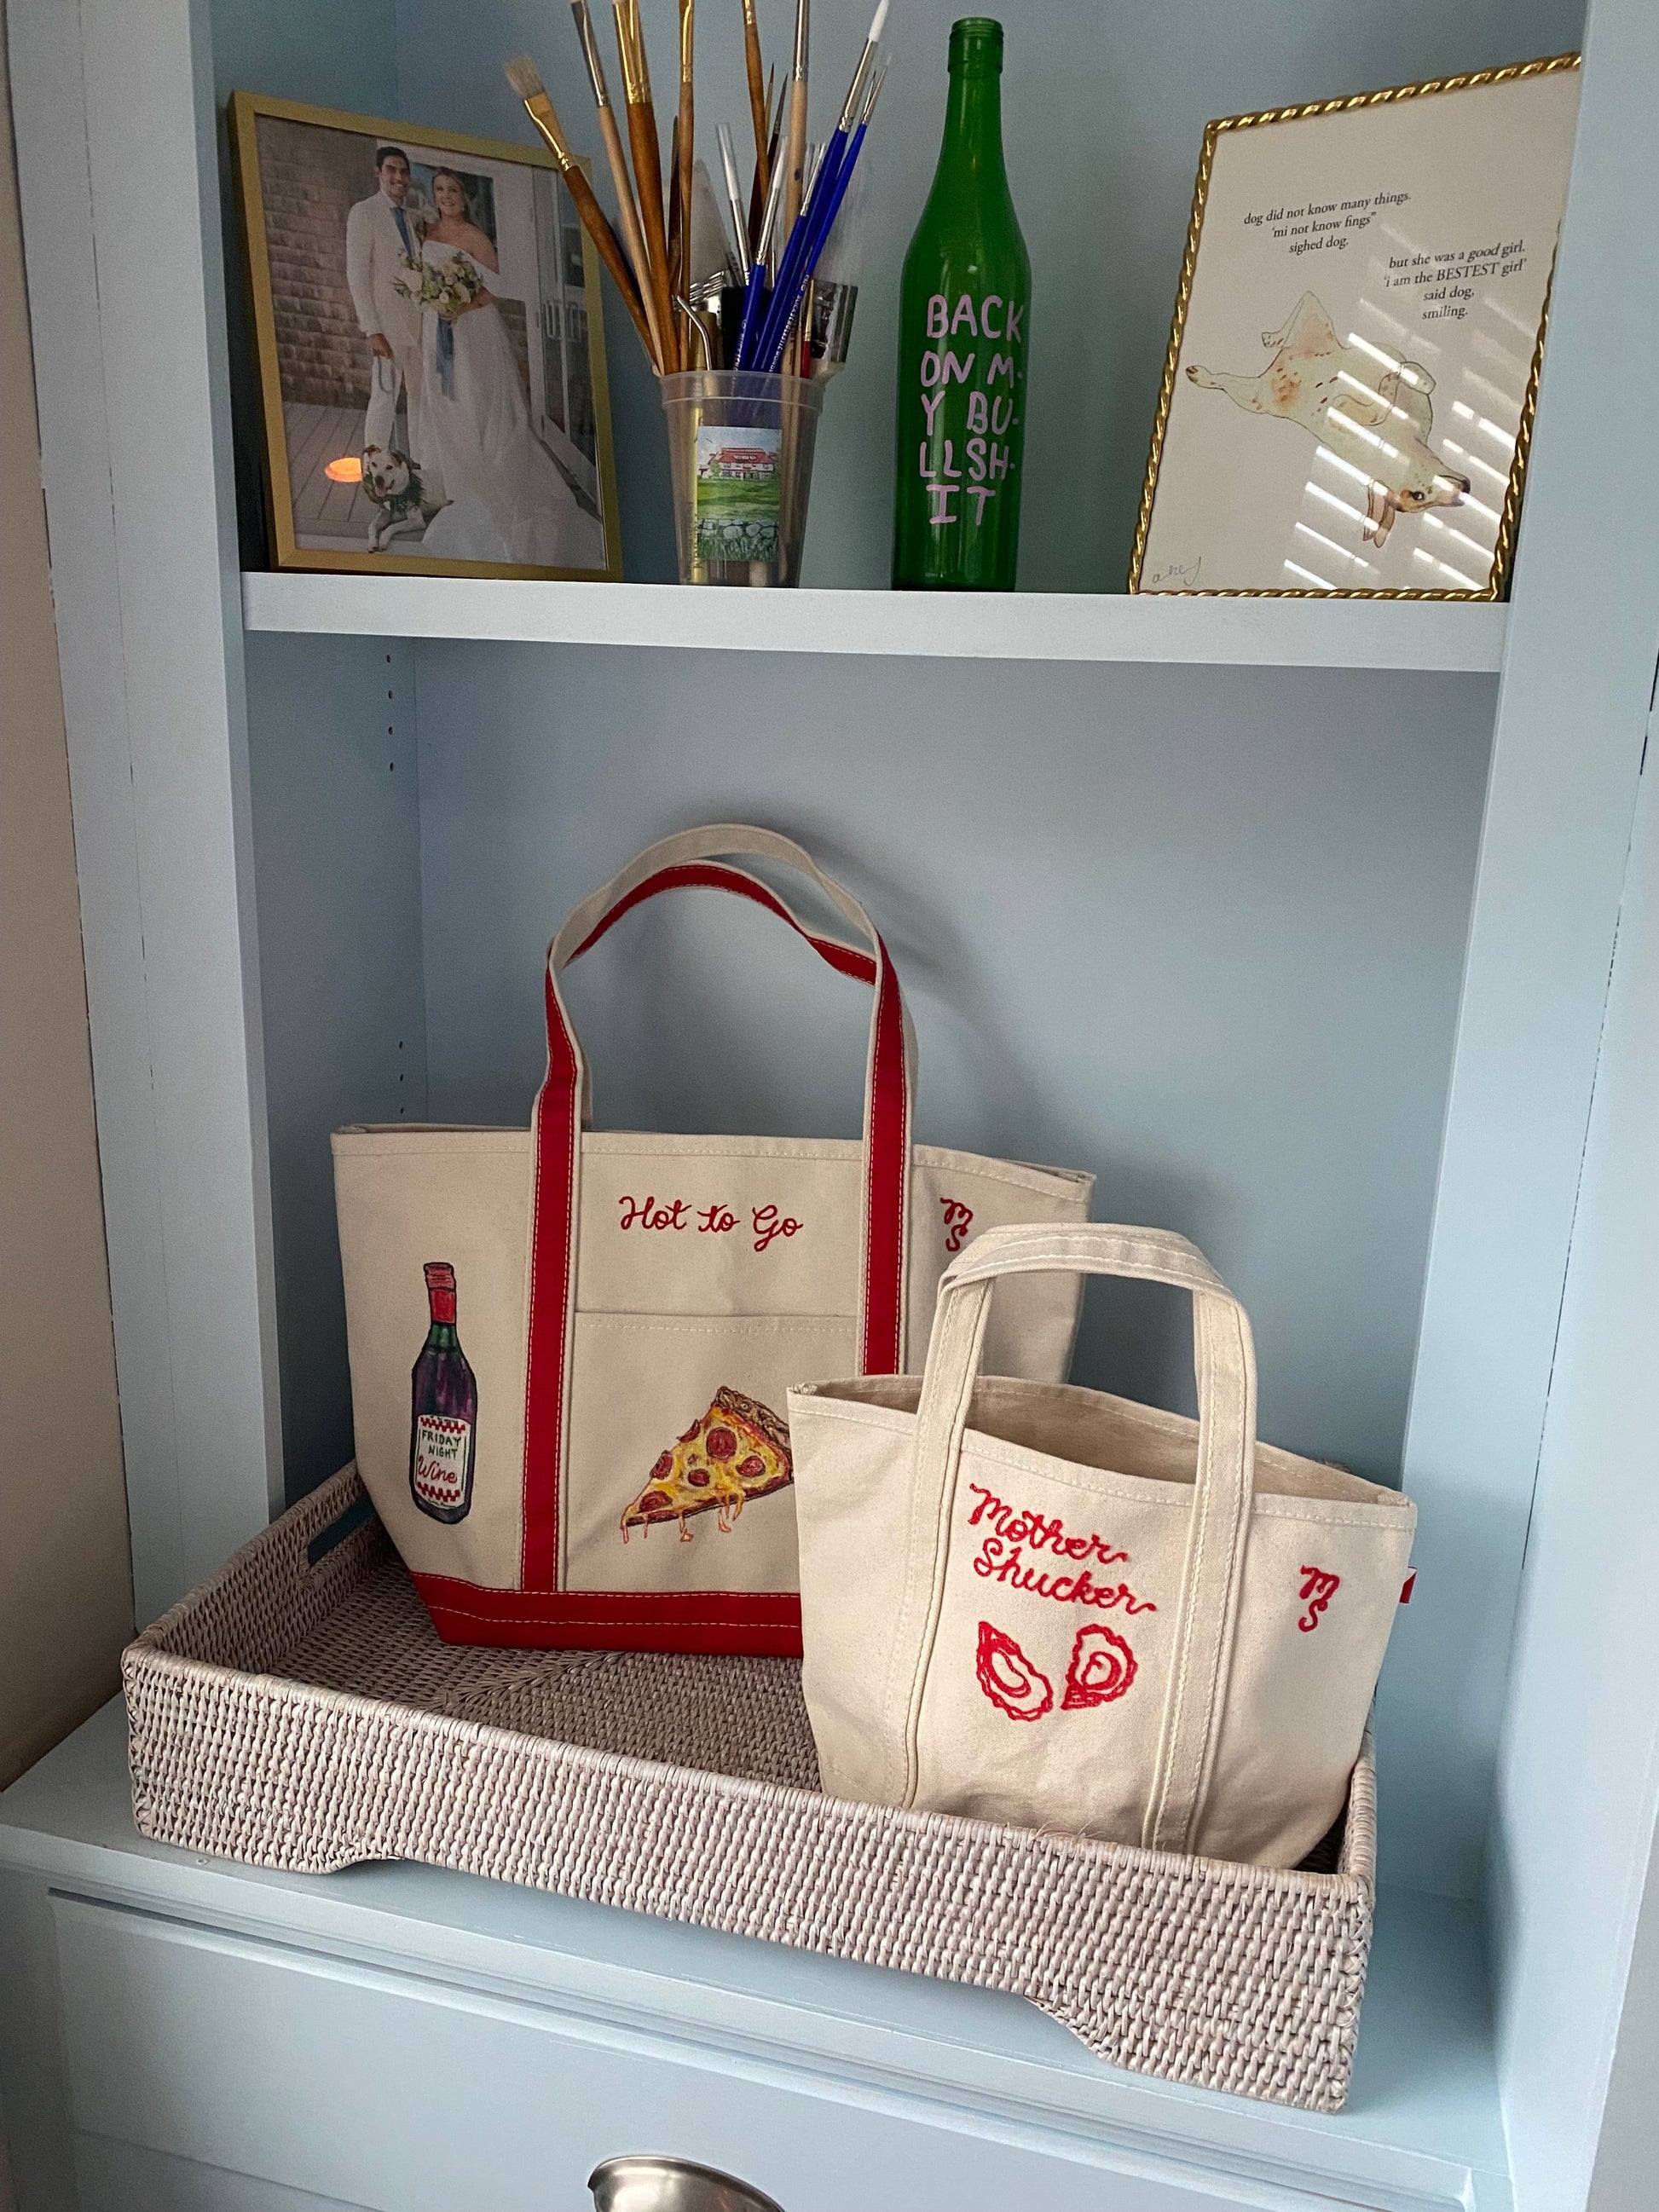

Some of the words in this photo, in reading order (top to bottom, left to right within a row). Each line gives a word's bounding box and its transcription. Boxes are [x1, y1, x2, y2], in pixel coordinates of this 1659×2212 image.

[1244, 213, 1263, 226] dog
[1266, 208, 1284, 222] did
[1286, 209, 1304, 219] not
[1308, 204, 1338, 215] know
[1341, 199, 1371, 211] many
[1374, 192, 1411, 206] things.
[1291, 226, 1309, 236] not
[1312, 220, 1342, 232] know
[1289, 237, 1323, 255] sighed
[1326, 235, 1349, 250] dog.
[1389, 257, 1408, 269] but
[1412, 253, 1431, 266] she
[1434, 252, 1455, 263] was
[1459, 251, 1465, 259] a
[1467, 242, 1500, 263] good
[1500, 240, 1525, 258] girl.
[1393, 276, 1411, 286] am
[1414, 271, 1433, 283] the
[1436, 262, 1500, 281] BESTEST
[1423, 286, 1446, 301] said
[1449, 285, 1475, 300] dog,
[927, 294, 1024, 343] BACK
[1422, 305, 1468, 320] smiling.
[921, 350, 975, 387] ON
[921, 390, 945, 436] Y
[926, 484, 996, 525] IT
[618, 1196, 692, 1230] Hot
[697, 1204, 741, 1233] to
[752, 1204, 804, 1252] Go
[421, 1429, 461, 1447] FRIDAY
[428, 1446, 459, 1460] NIGHT
[418, 1455, 458, 1483] Wine
[968, 1482, 1129, 1564] Mother
[974, 1537, 1158, 1615] Shucker
